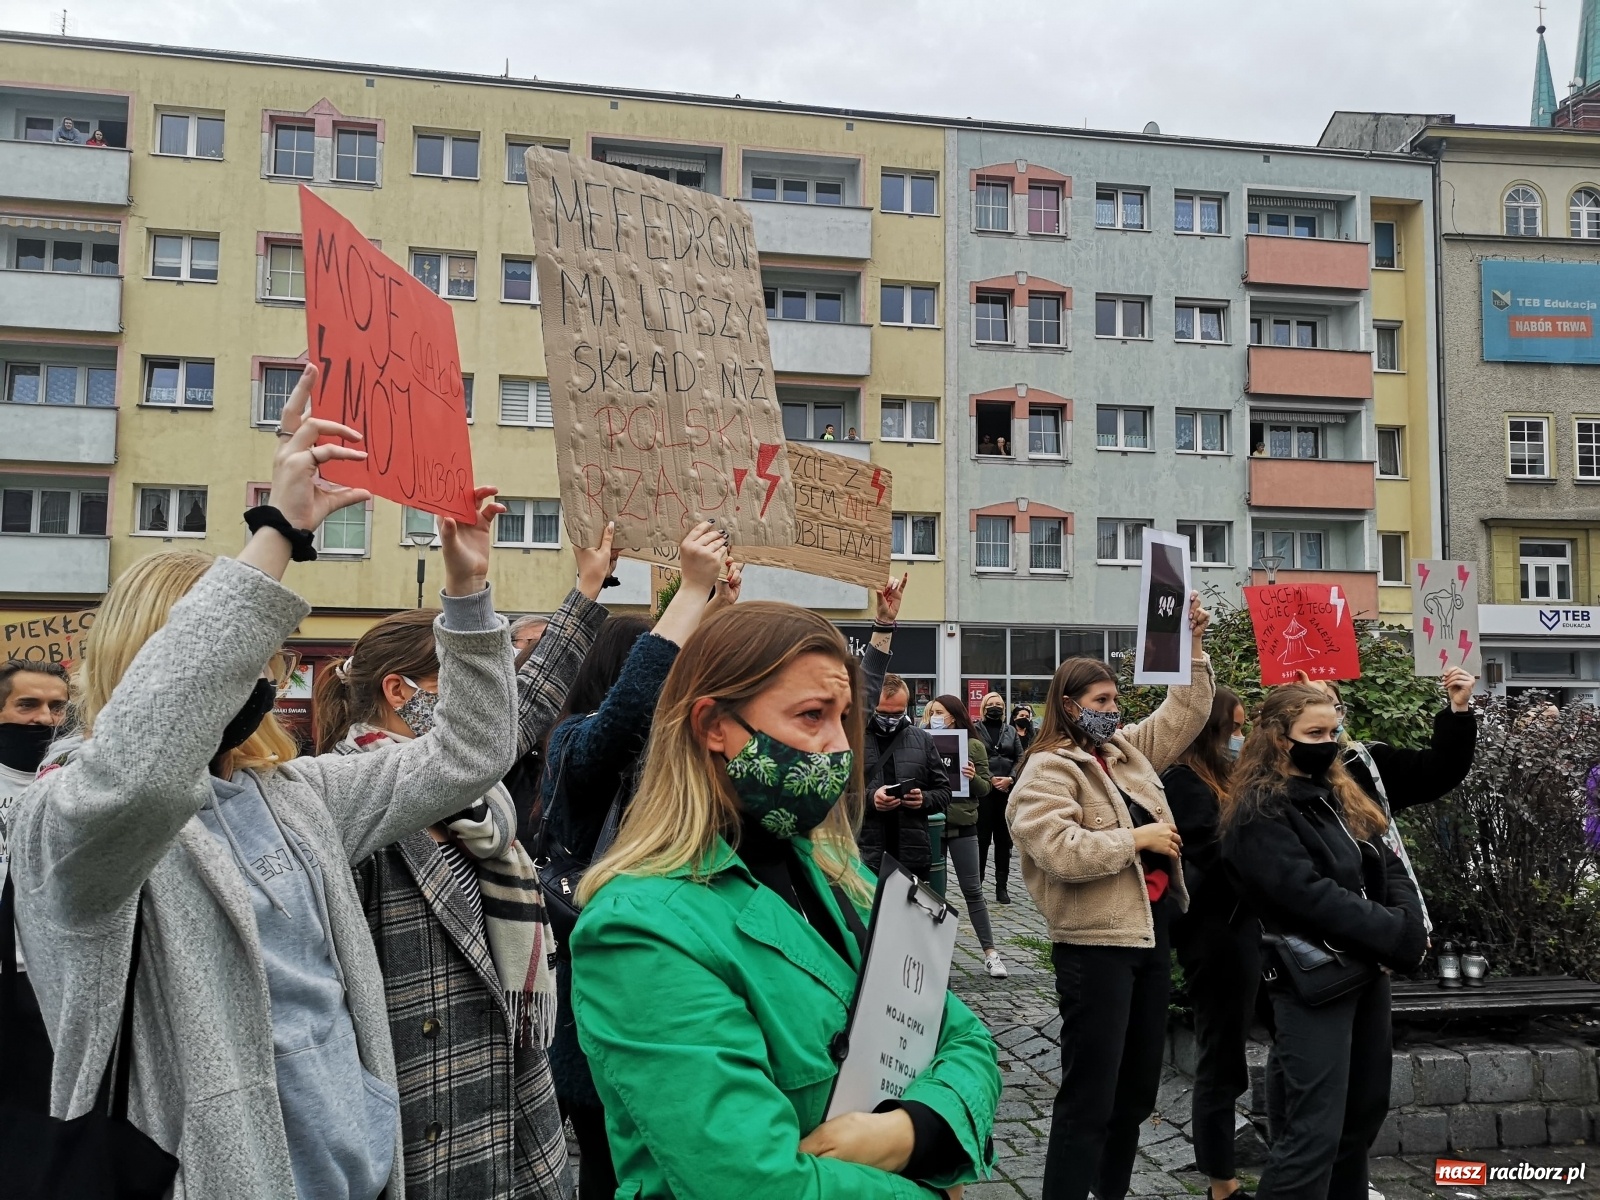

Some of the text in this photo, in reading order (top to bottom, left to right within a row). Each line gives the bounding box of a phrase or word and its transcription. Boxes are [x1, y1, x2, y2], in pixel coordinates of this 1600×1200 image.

[550, 176, 749, 270] MEFEDRON
[314, 228, 461, 398] MOJE CIAŁO
[560, 269, 753, 343] MA LEPSZY
[1517, 298, 1597, 311] TEB Edukacja
[1515, 318, 1587, 332] NABÓR TRWA
[574, 344, 769, 401] SKŁAD NIŻ
[342, 357, 469, 511] MÓJ WYBÓR
[594, 406, 753, 459] POLSKI
[791, 453, 861, 490] ZCIE Z
[845, 494, 875, 522] NIE
[1259, 586, 1309, 606] CHCEMY
[1307, 602, 1333, 615] TEGO
[4, 612, 96, 642] PIEKŁO
[1562, 610, 1591, 621] TEB
[7, 636, 87, 663] KOBIE
[885, 1004, 925, 1037] MOJA CIPKA
[899, 1036, 907, 1051] TO
[880, 1052, 917, 1080] NIE TWOJA
[880, 1078, 906, 1098] BROSZ
